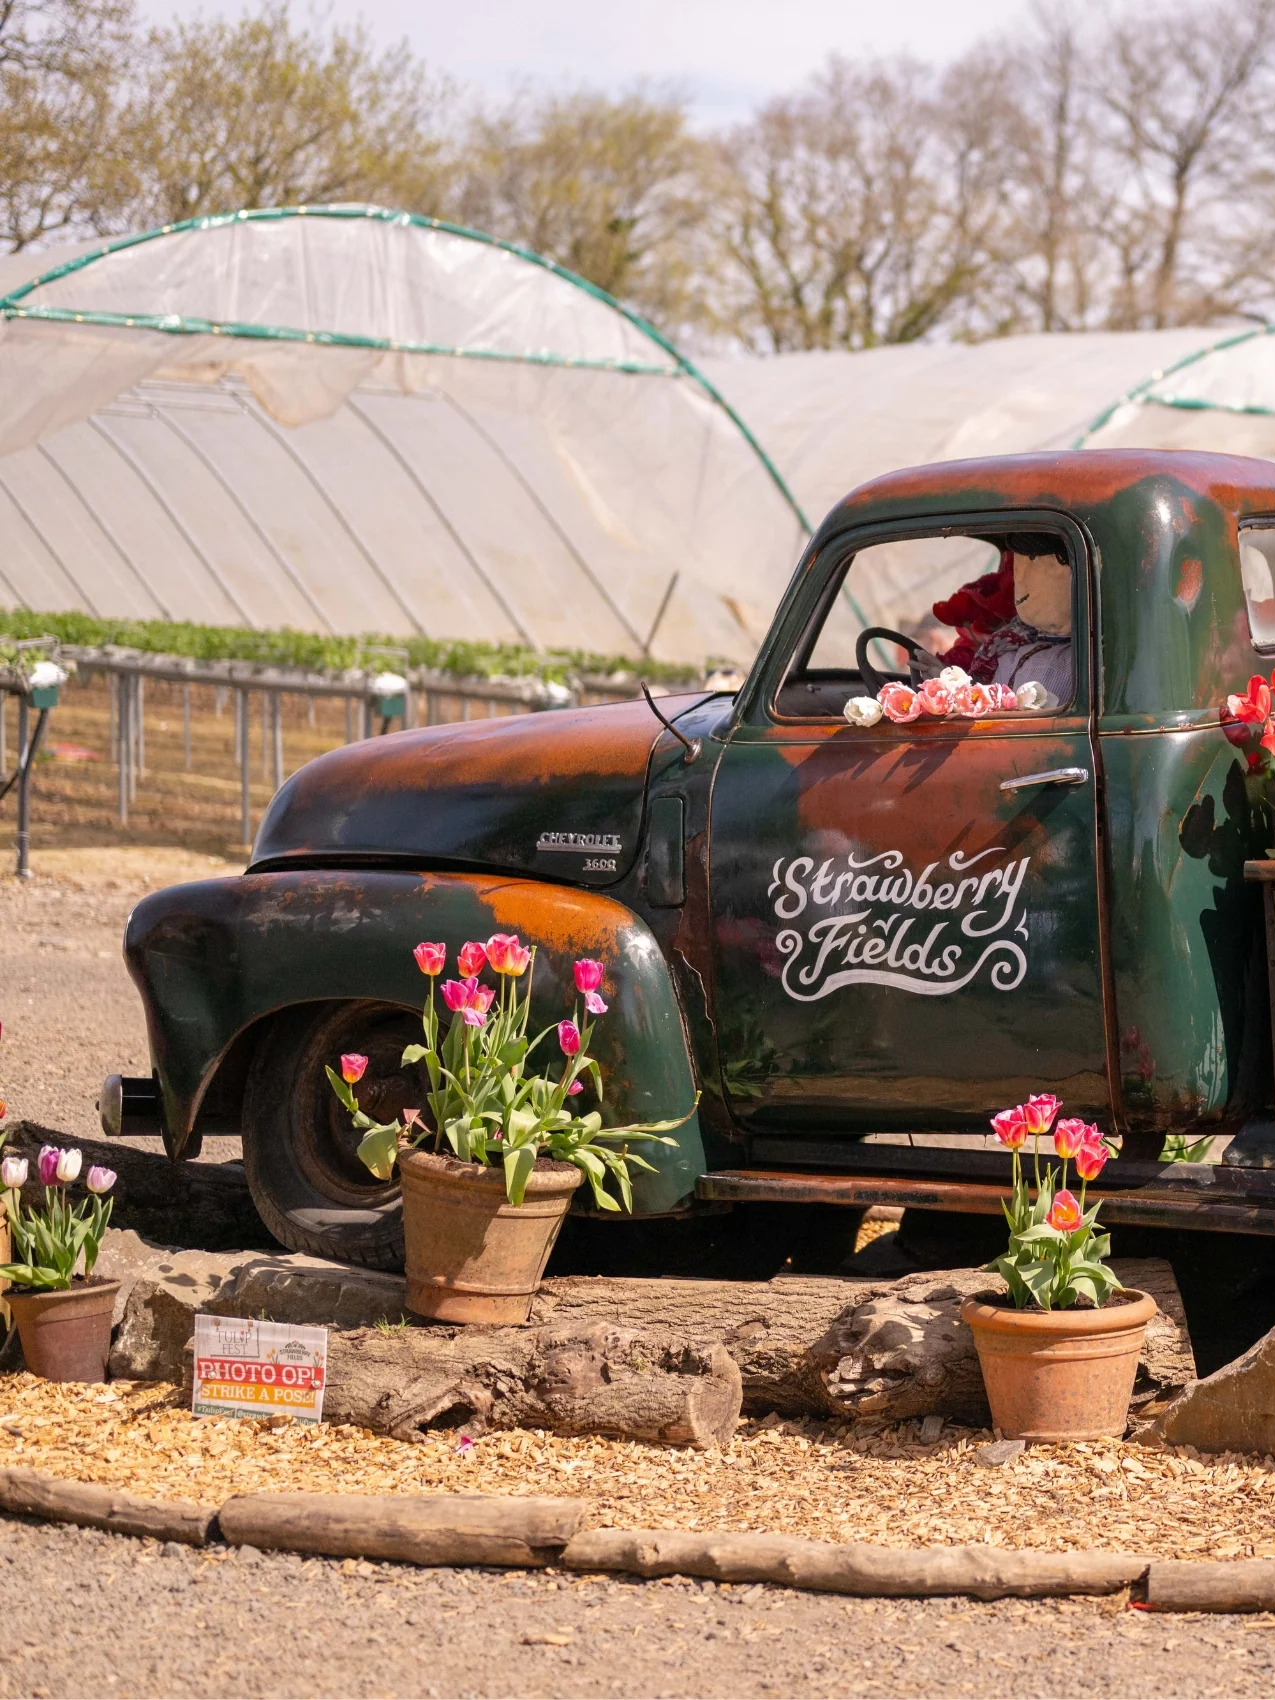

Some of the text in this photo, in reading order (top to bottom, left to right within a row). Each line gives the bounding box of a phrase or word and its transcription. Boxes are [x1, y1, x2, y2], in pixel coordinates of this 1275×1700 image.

[540, 832, 620, 846] CHEVROLET
[584, 858, 616, 871] 3600
[773, 853, 1031, 937] Strawberry
[799, 908, 962, 985] Fields
[222, 1343, 249, 1355] FEST
[279, 1348, 311, 1357] STRAWBERRY
[199, 1361, 316, 1386] PHOTO OP!
[201, 1383, 256, 1399] STRIKE
[259, 1387, 270, 1401] A
